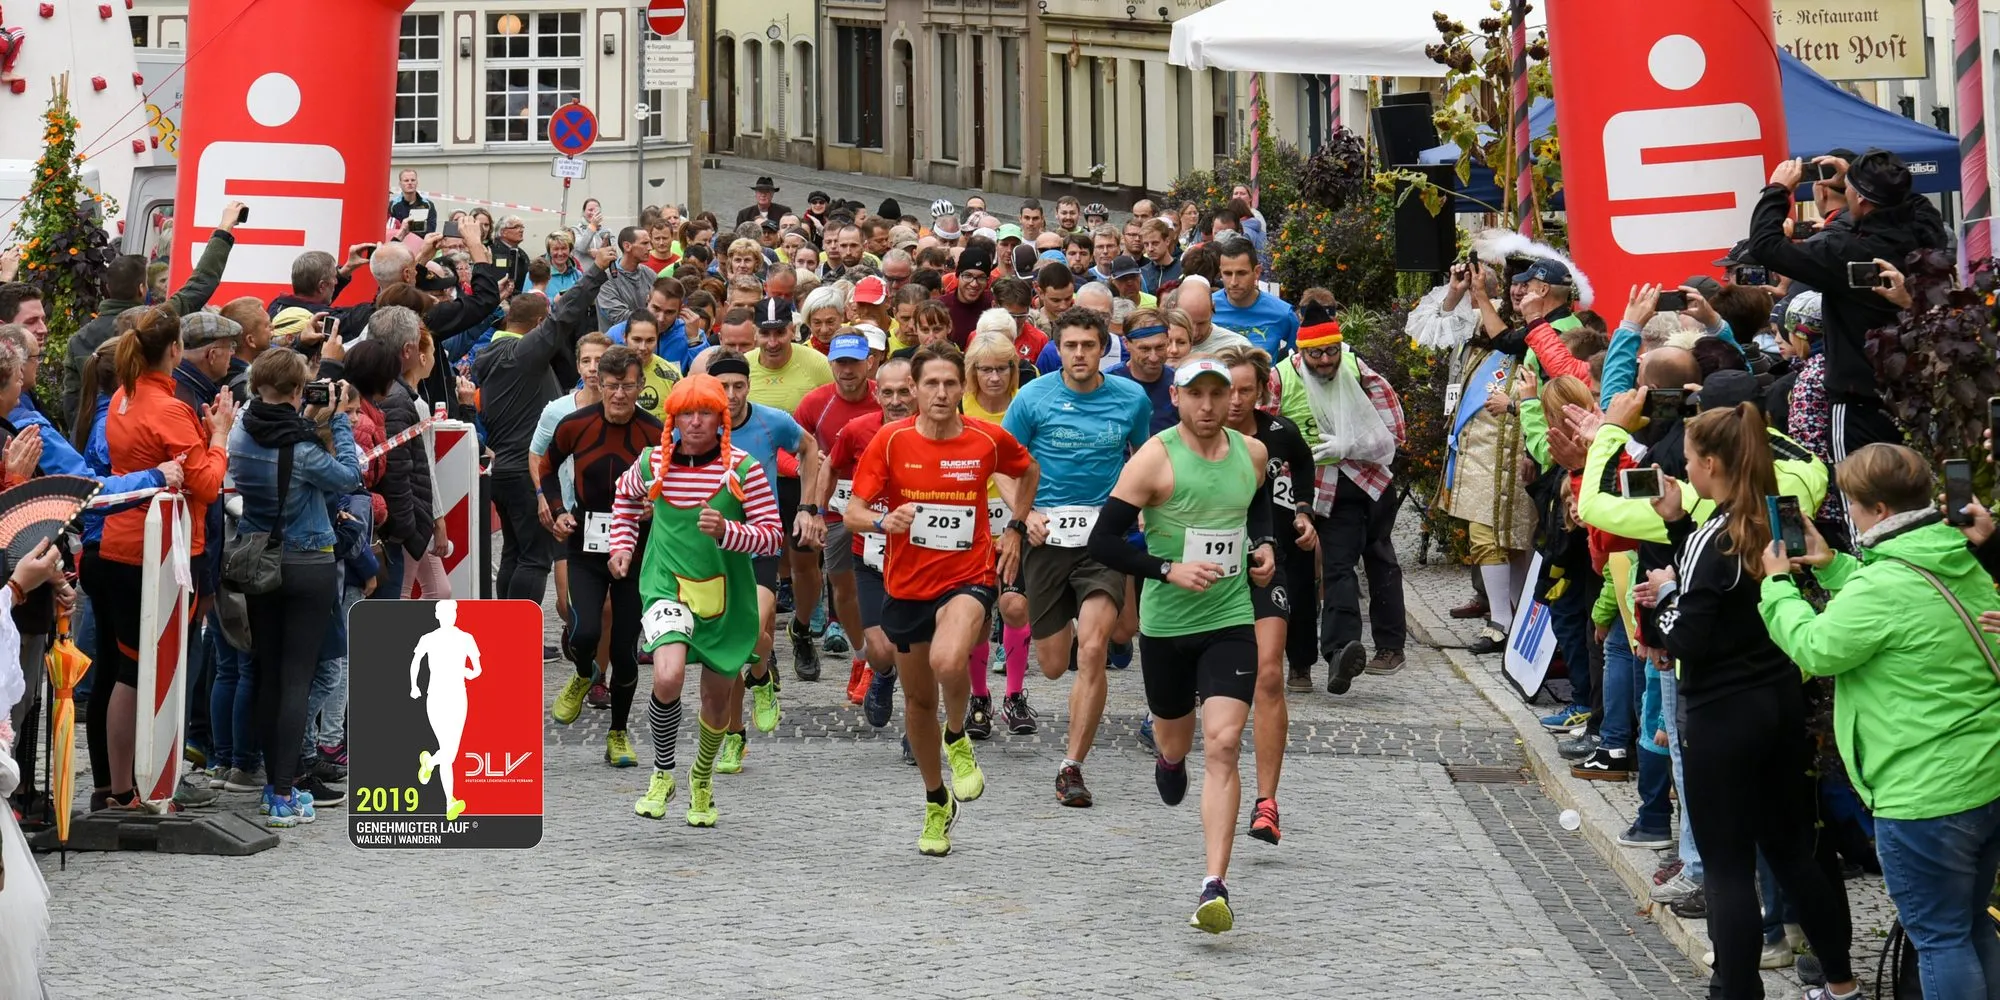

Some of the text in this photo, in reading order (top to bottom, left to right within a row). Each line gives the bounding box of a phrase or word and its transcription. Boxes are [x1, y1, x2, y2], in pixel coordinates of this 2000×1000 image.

[927, 515, 961, 529] 203
[1060, 517, 1087, 528] 278
[1205, 541, 1233, 555] 191
[654, 608, 682, 621] 263
